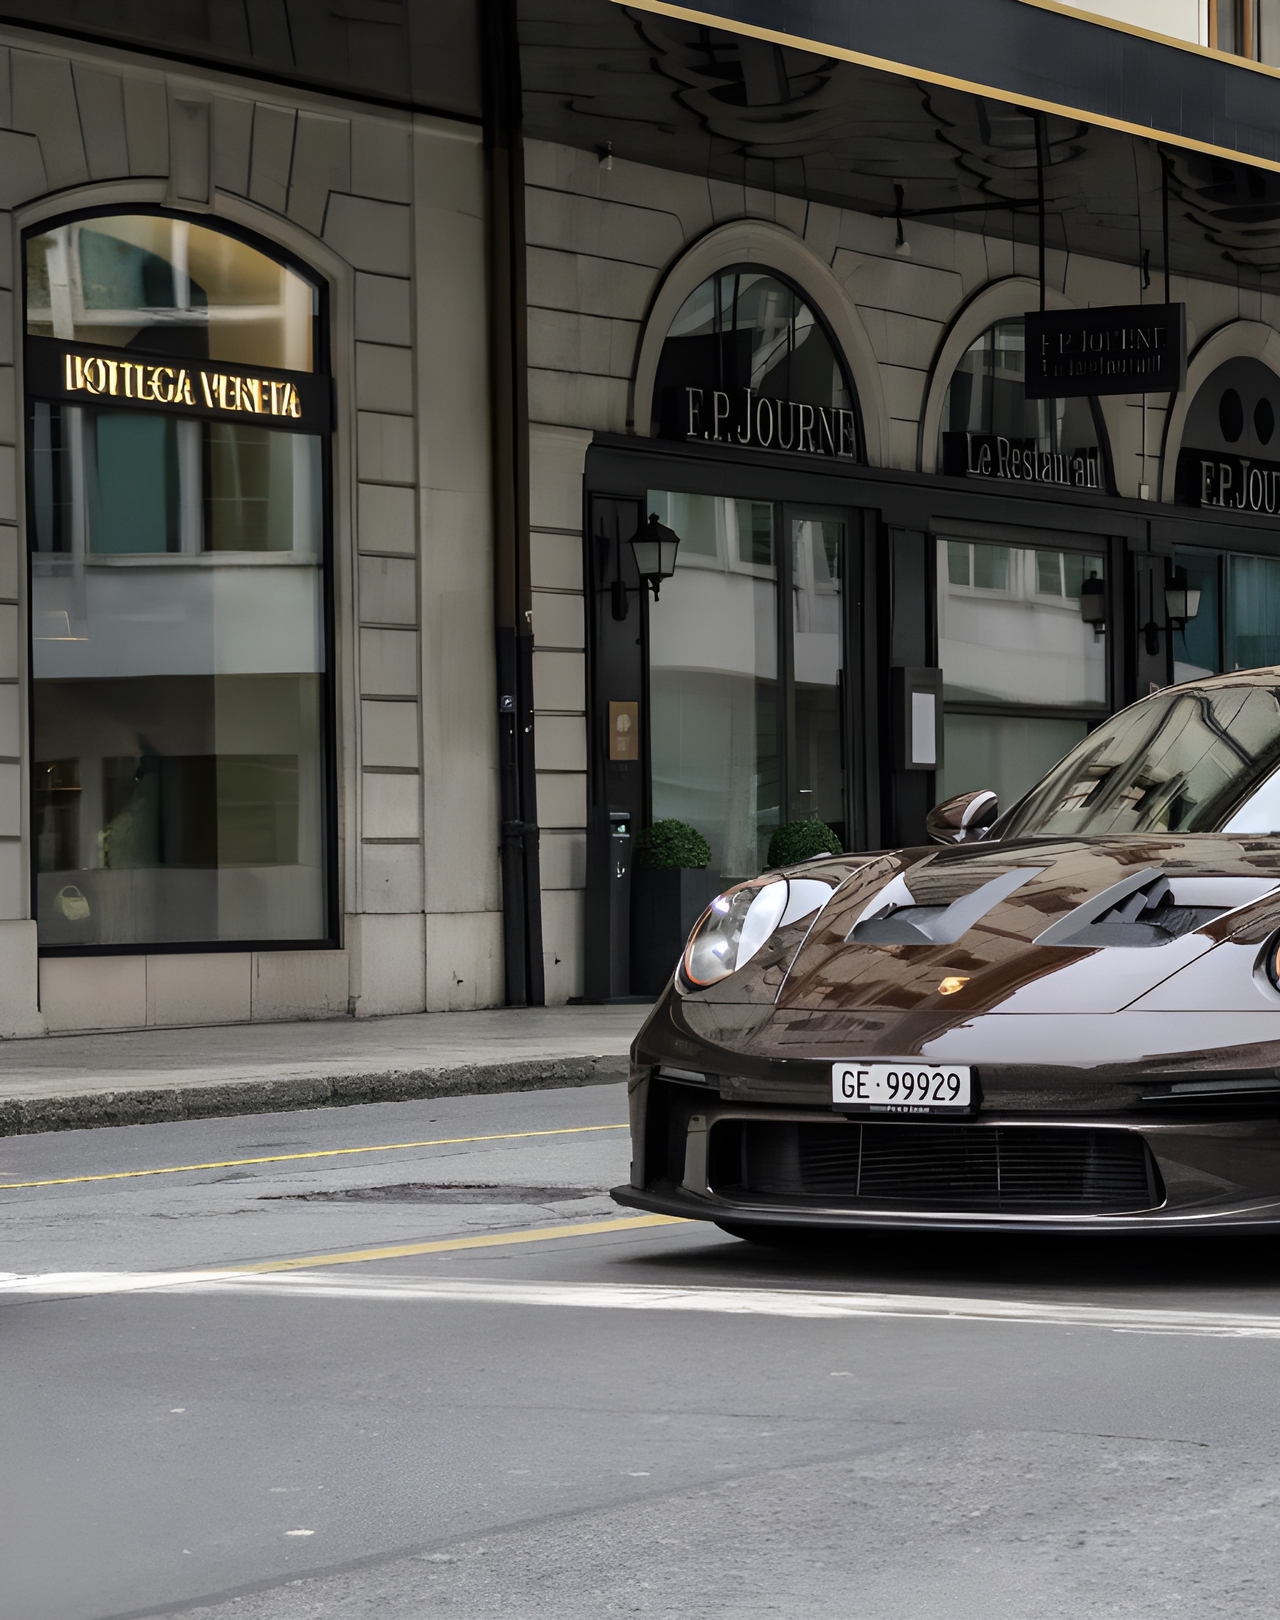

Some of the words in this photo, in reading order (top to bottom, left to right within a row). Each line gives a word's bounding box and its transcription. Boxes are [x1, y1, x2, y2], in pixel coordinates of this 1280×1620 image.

[65, 354, 196, 405] BOTTEGA
[200, 371, 302, 418] VENETA
[967, 432, 991, 475] Le
